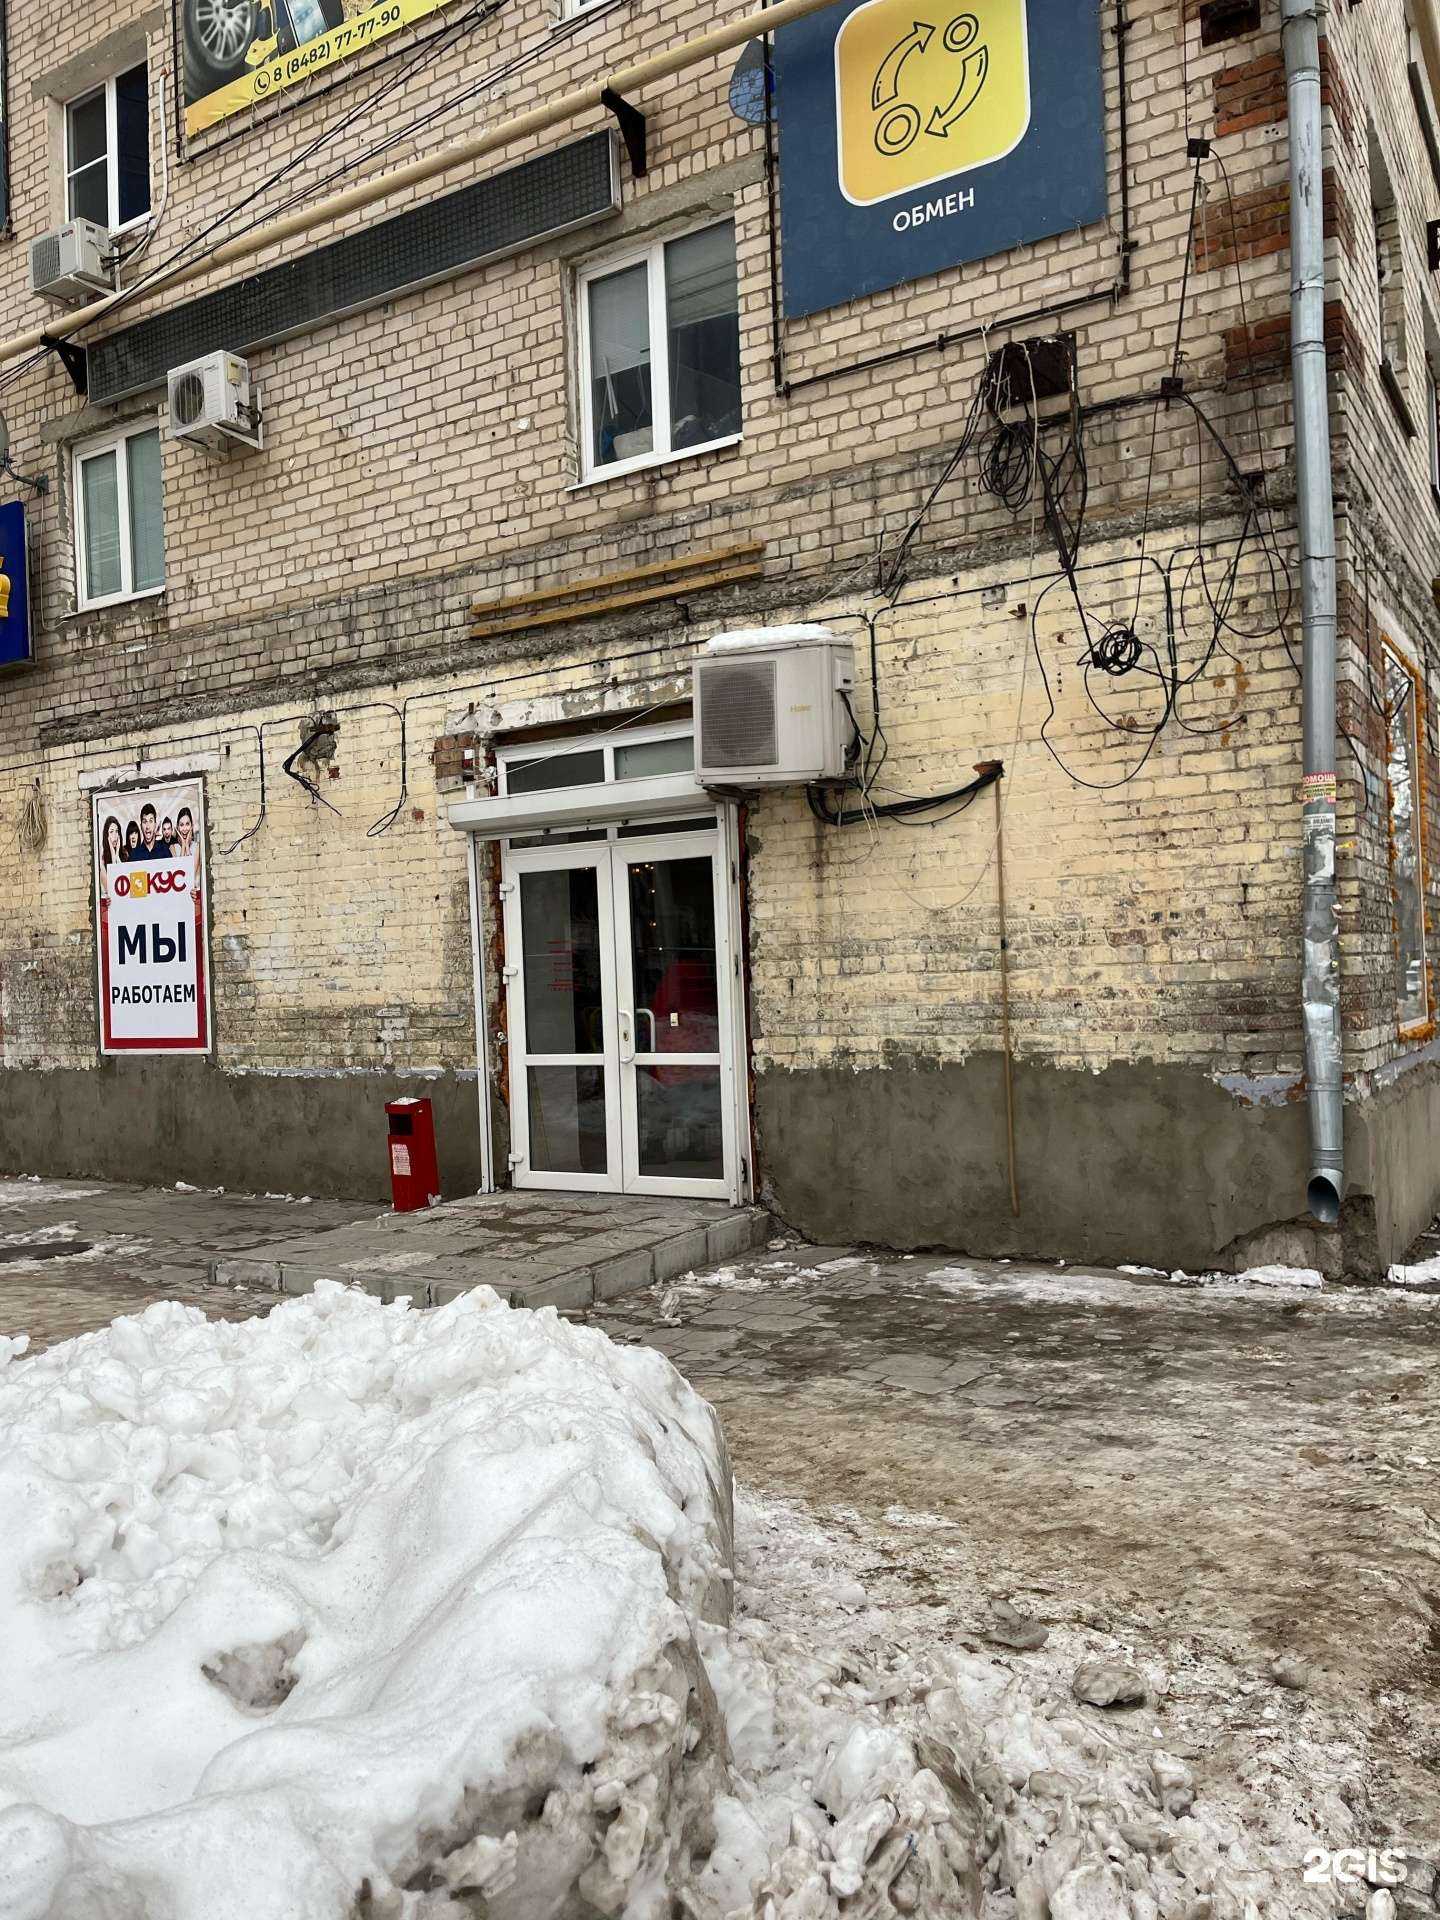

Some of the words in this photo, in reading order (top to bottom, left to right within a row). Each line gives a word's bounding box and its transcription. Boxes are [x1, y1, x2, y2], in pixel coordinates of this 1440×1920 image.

[273, 67, 283, 82] 8
[286, 41, 330, 79] (8482)
[334, 5, 400, 50] 77-77-90
[892, 187, 975, 232] ОБМЕН
[118, 921, 187, 965] МЫ
[111, 983, 196, 1005] РАБОТАЕМ
